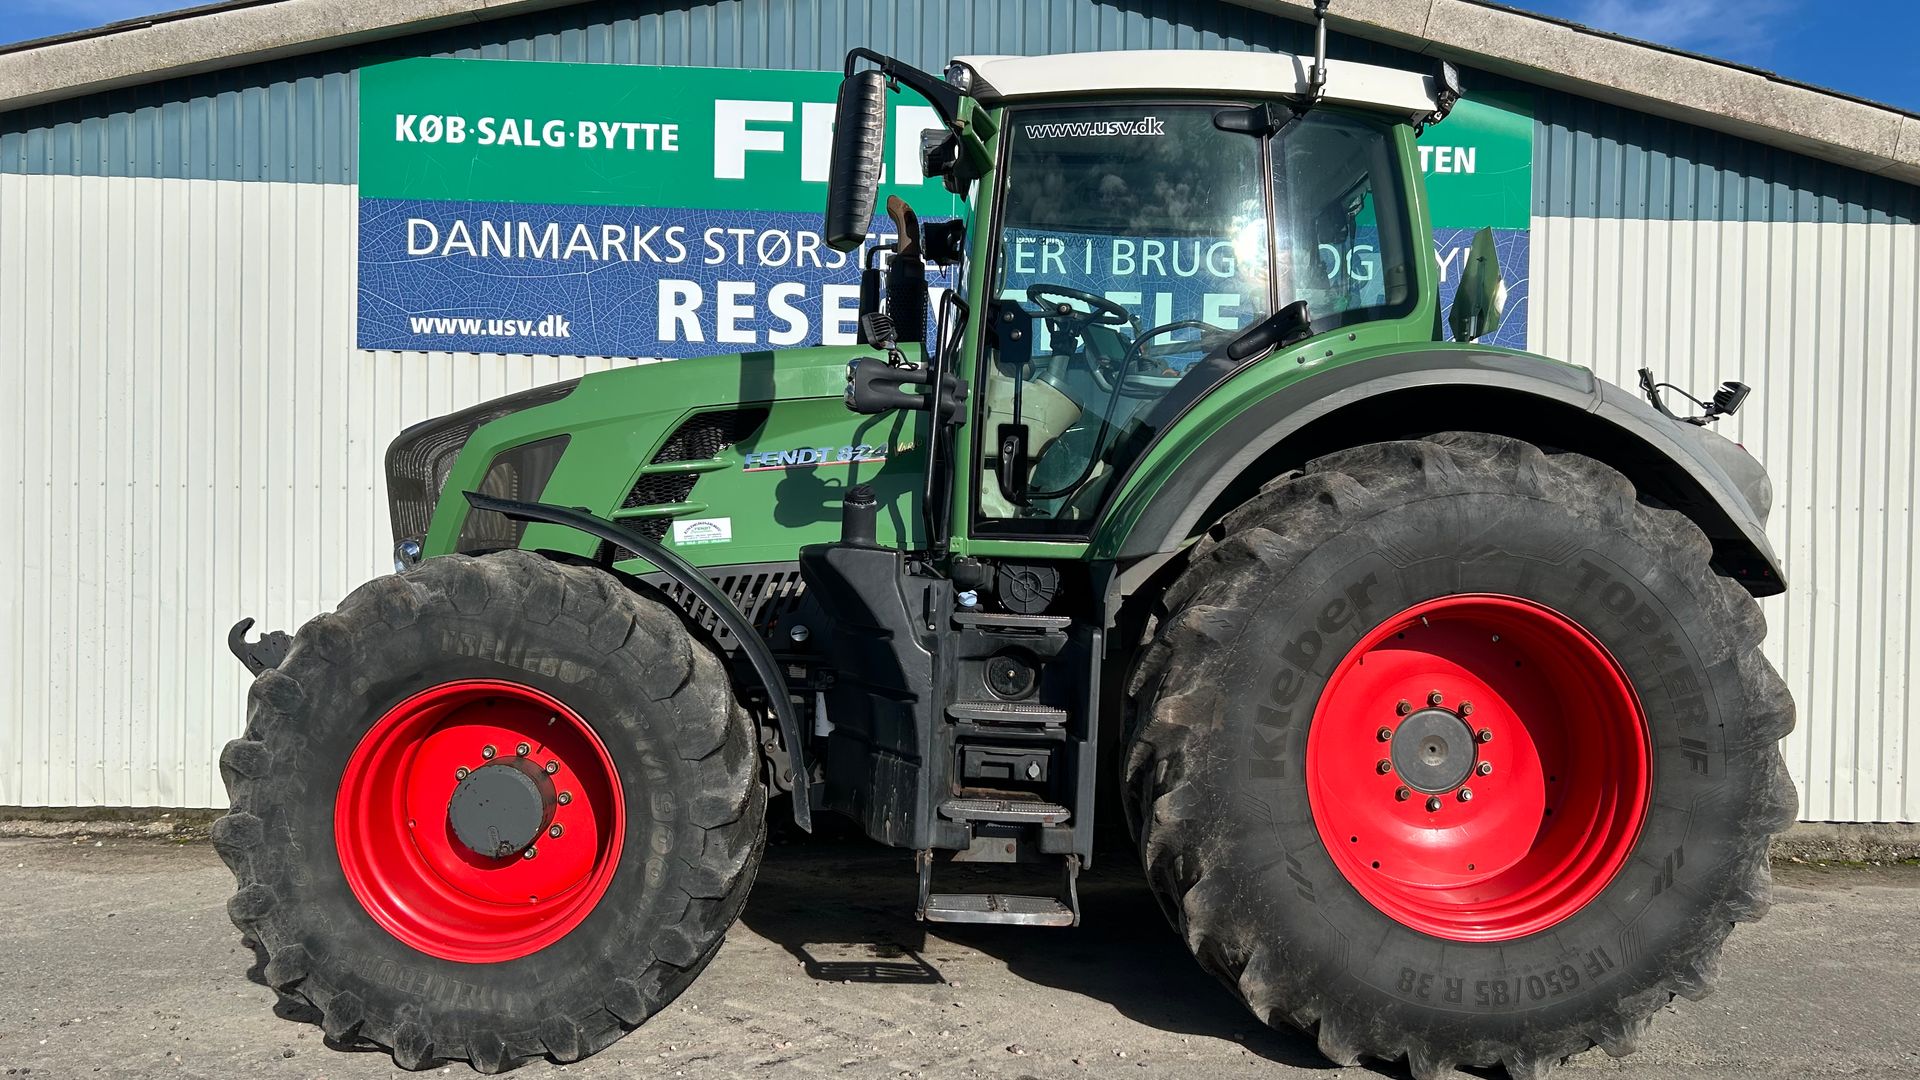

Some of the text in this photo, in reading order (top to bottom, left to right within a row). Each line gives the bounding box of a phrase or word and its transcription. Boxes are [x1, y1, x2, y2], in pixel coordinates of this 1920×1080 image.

[1026, 116, 1164, 138] www.usv.dk
[407, 217, 688, 263] DANMARKS
[410, 313, 570, 339] www.usv.dk
[744, 445, 834, 469] FENDT
[836, 442, 889, 462] 824
[1249, 570, 1379, 779] Kleber
[1397, 966, 1436, 999] 38
[1442, 976, 1464, 1005] R
[1473, 963, 1581, 1008] 650/85
